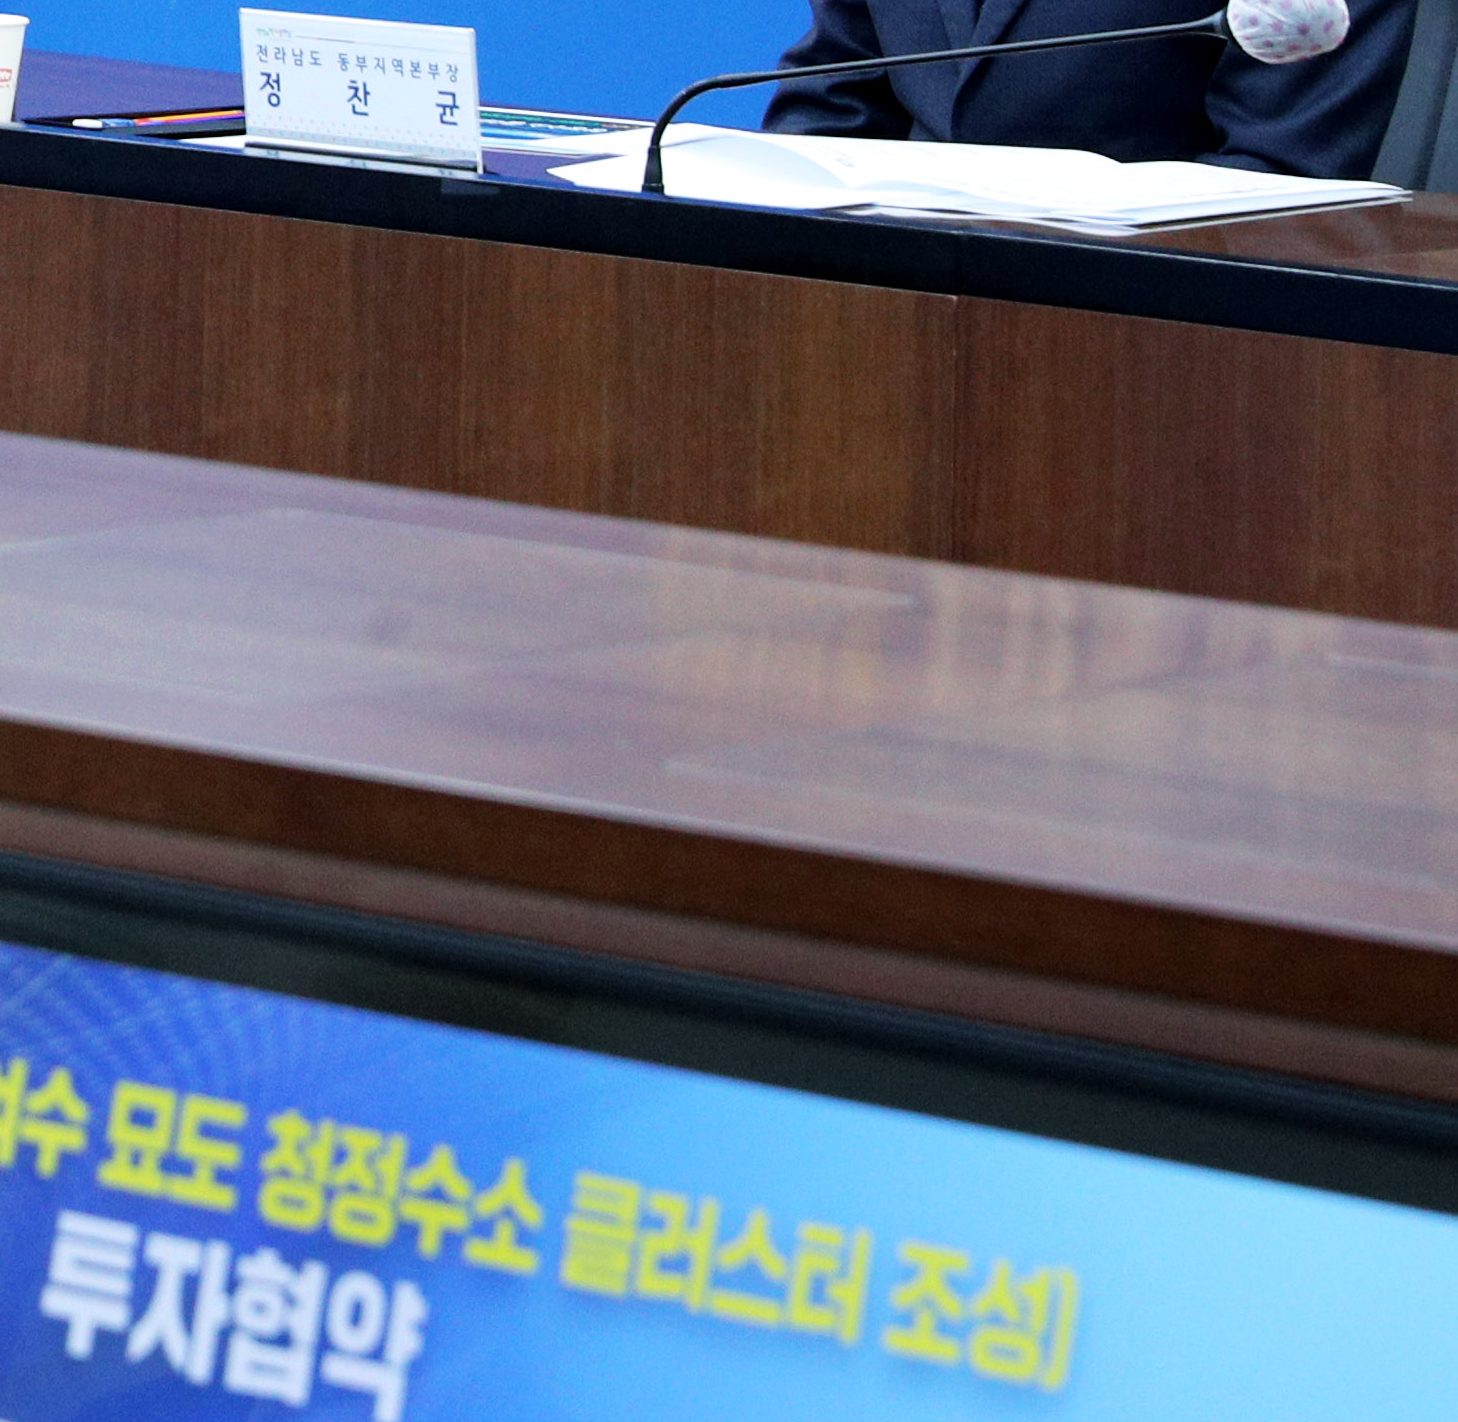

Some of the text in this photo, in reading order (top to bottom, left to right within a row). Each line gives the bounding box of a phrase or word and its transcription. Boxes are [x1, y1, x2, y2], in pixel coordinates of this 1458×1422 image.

[255, 44, 459, 84] 전라남도 동부지역본부장
[41, 1208, 429, 1421] 투자협약
[98, 1079, 249, 1212] 묘도
[257, 1106, 545, 1274] 청정수소
[559, 1170, 873, 1346] 클러스터
[882, 1242, 1077, 1392] 조성)
